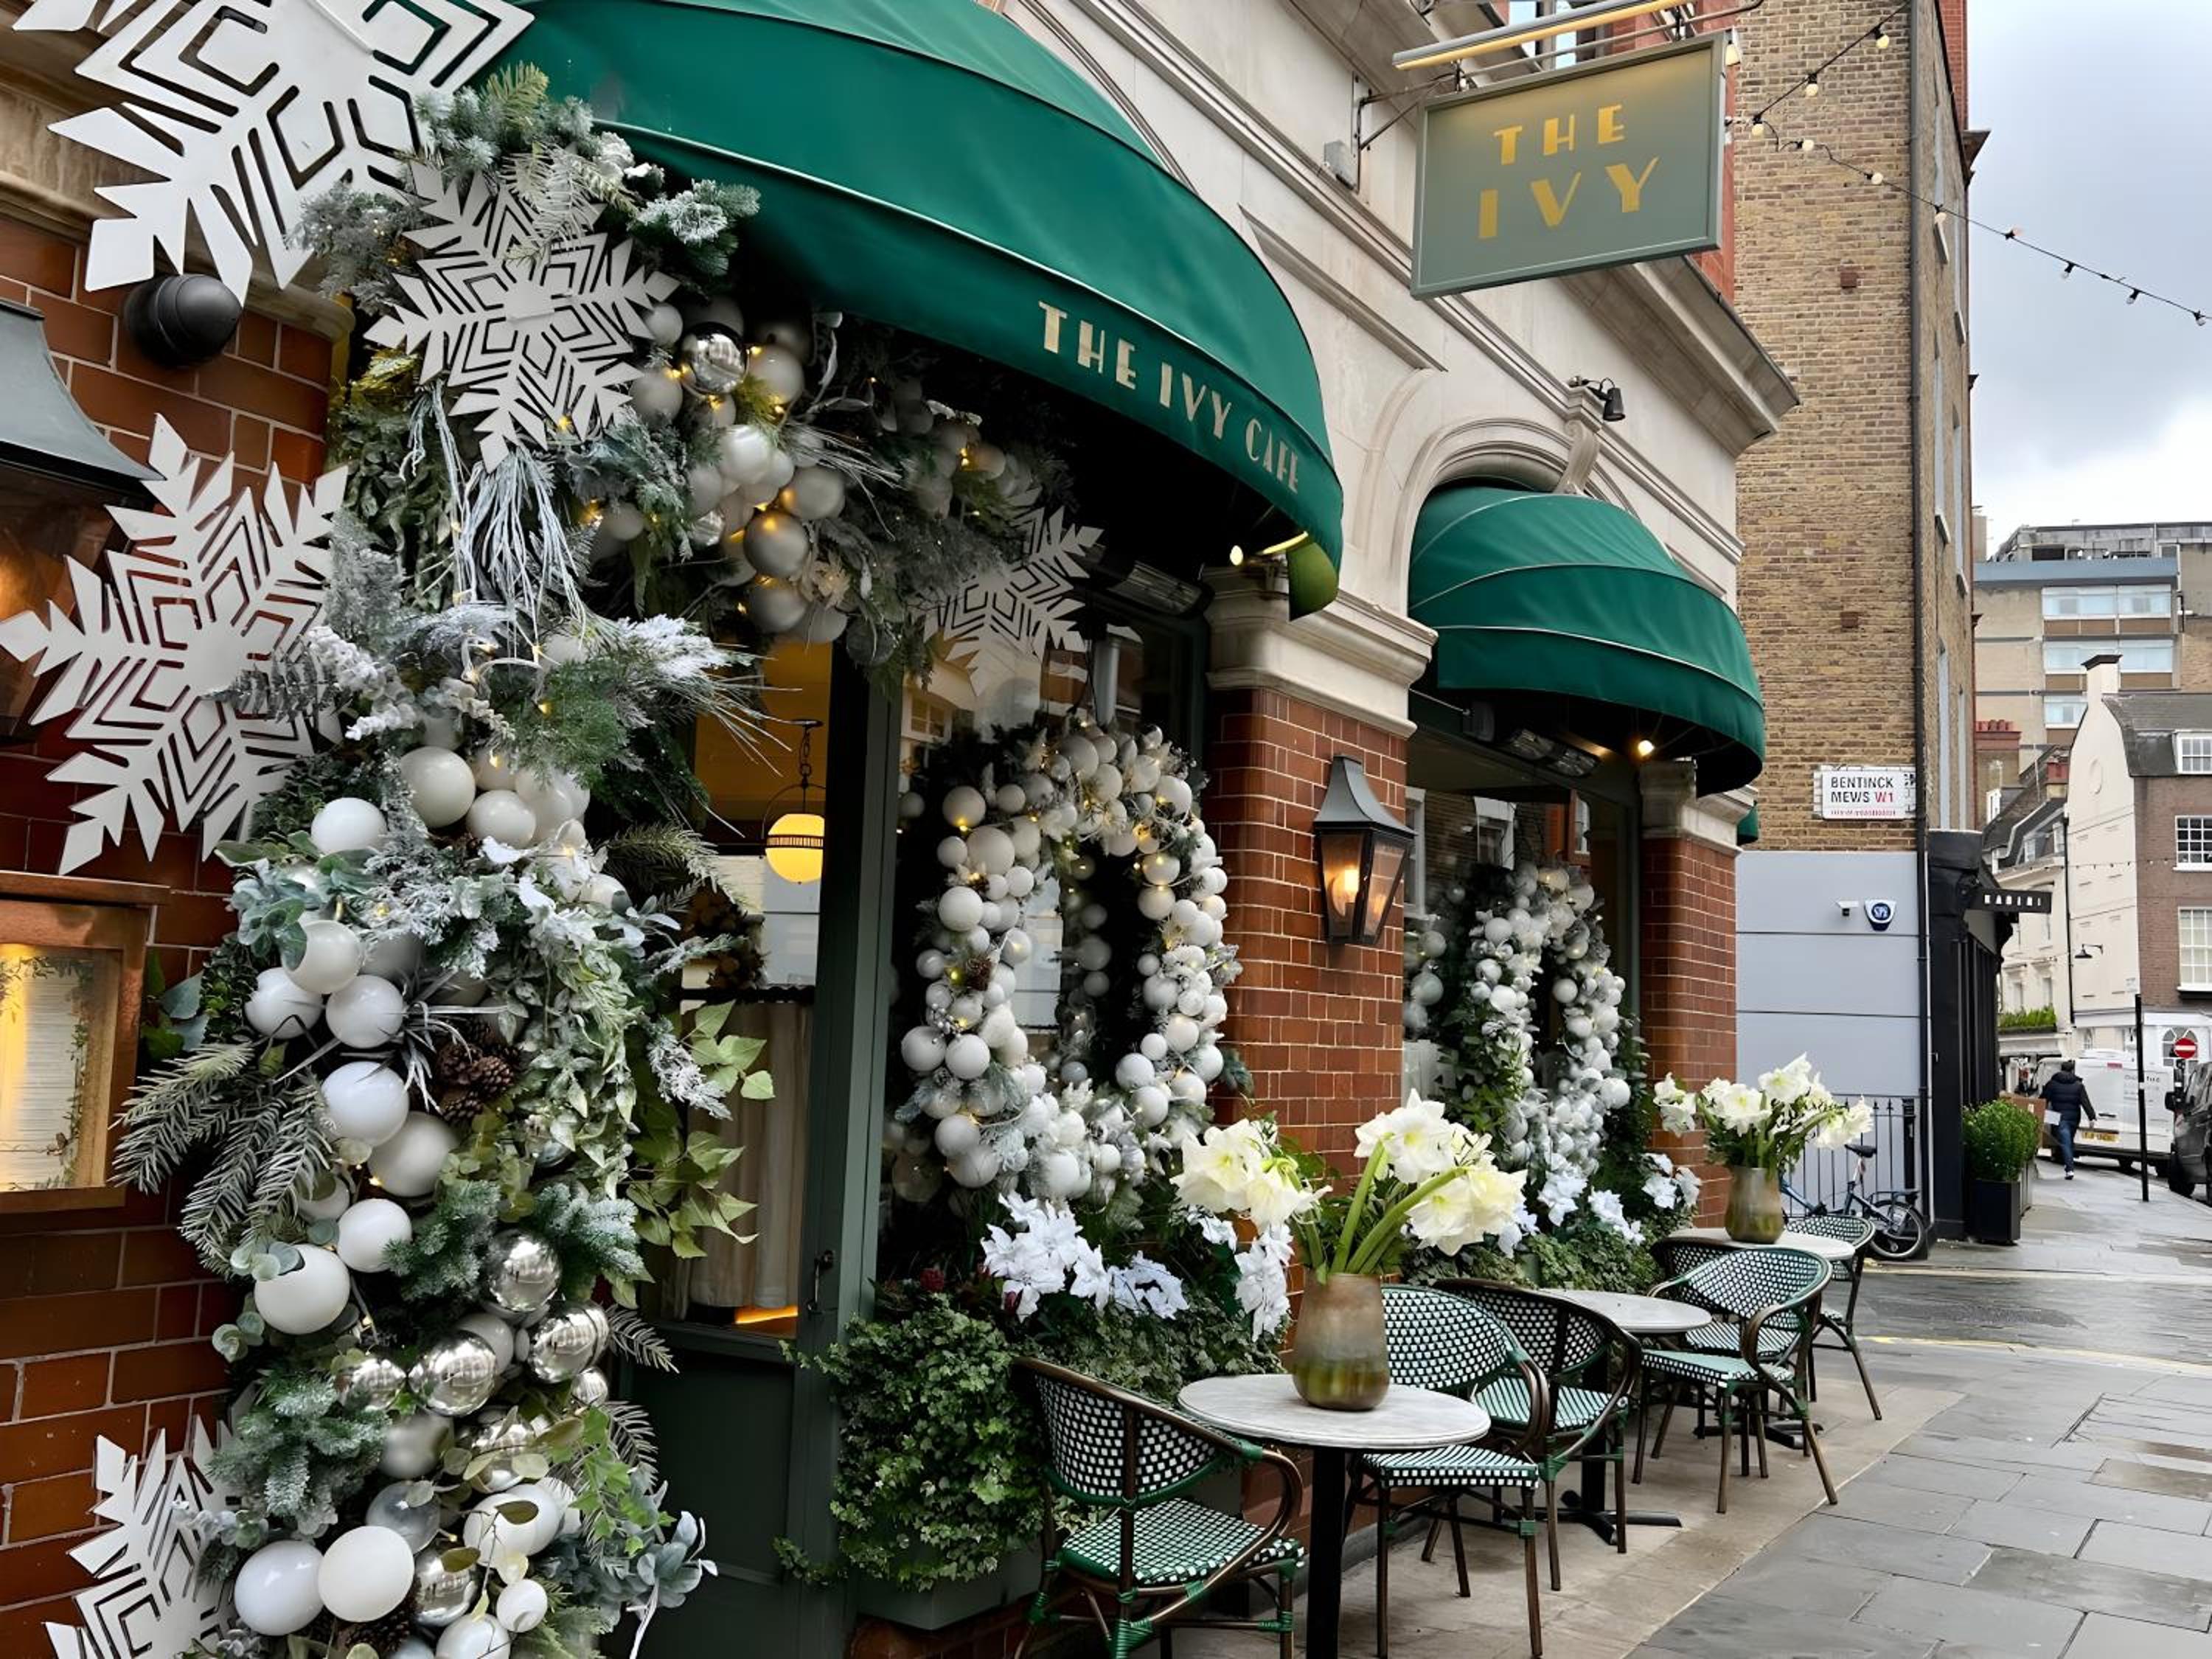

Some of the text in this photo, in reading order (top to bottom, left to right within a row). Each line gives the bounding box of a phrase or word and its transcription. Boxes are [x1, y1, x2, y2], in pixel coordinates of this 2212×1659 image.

[1494, 104, 1625, 165] THE
[1478, 156, 1660, 239] IVY
[1038, 301, 1137, 390] THE
[1159, 362, 1232, 440] IVY
[1831, 776, 1894, 788] BENTINCK
[1831, 791, 1894, 803] MEWS W1
